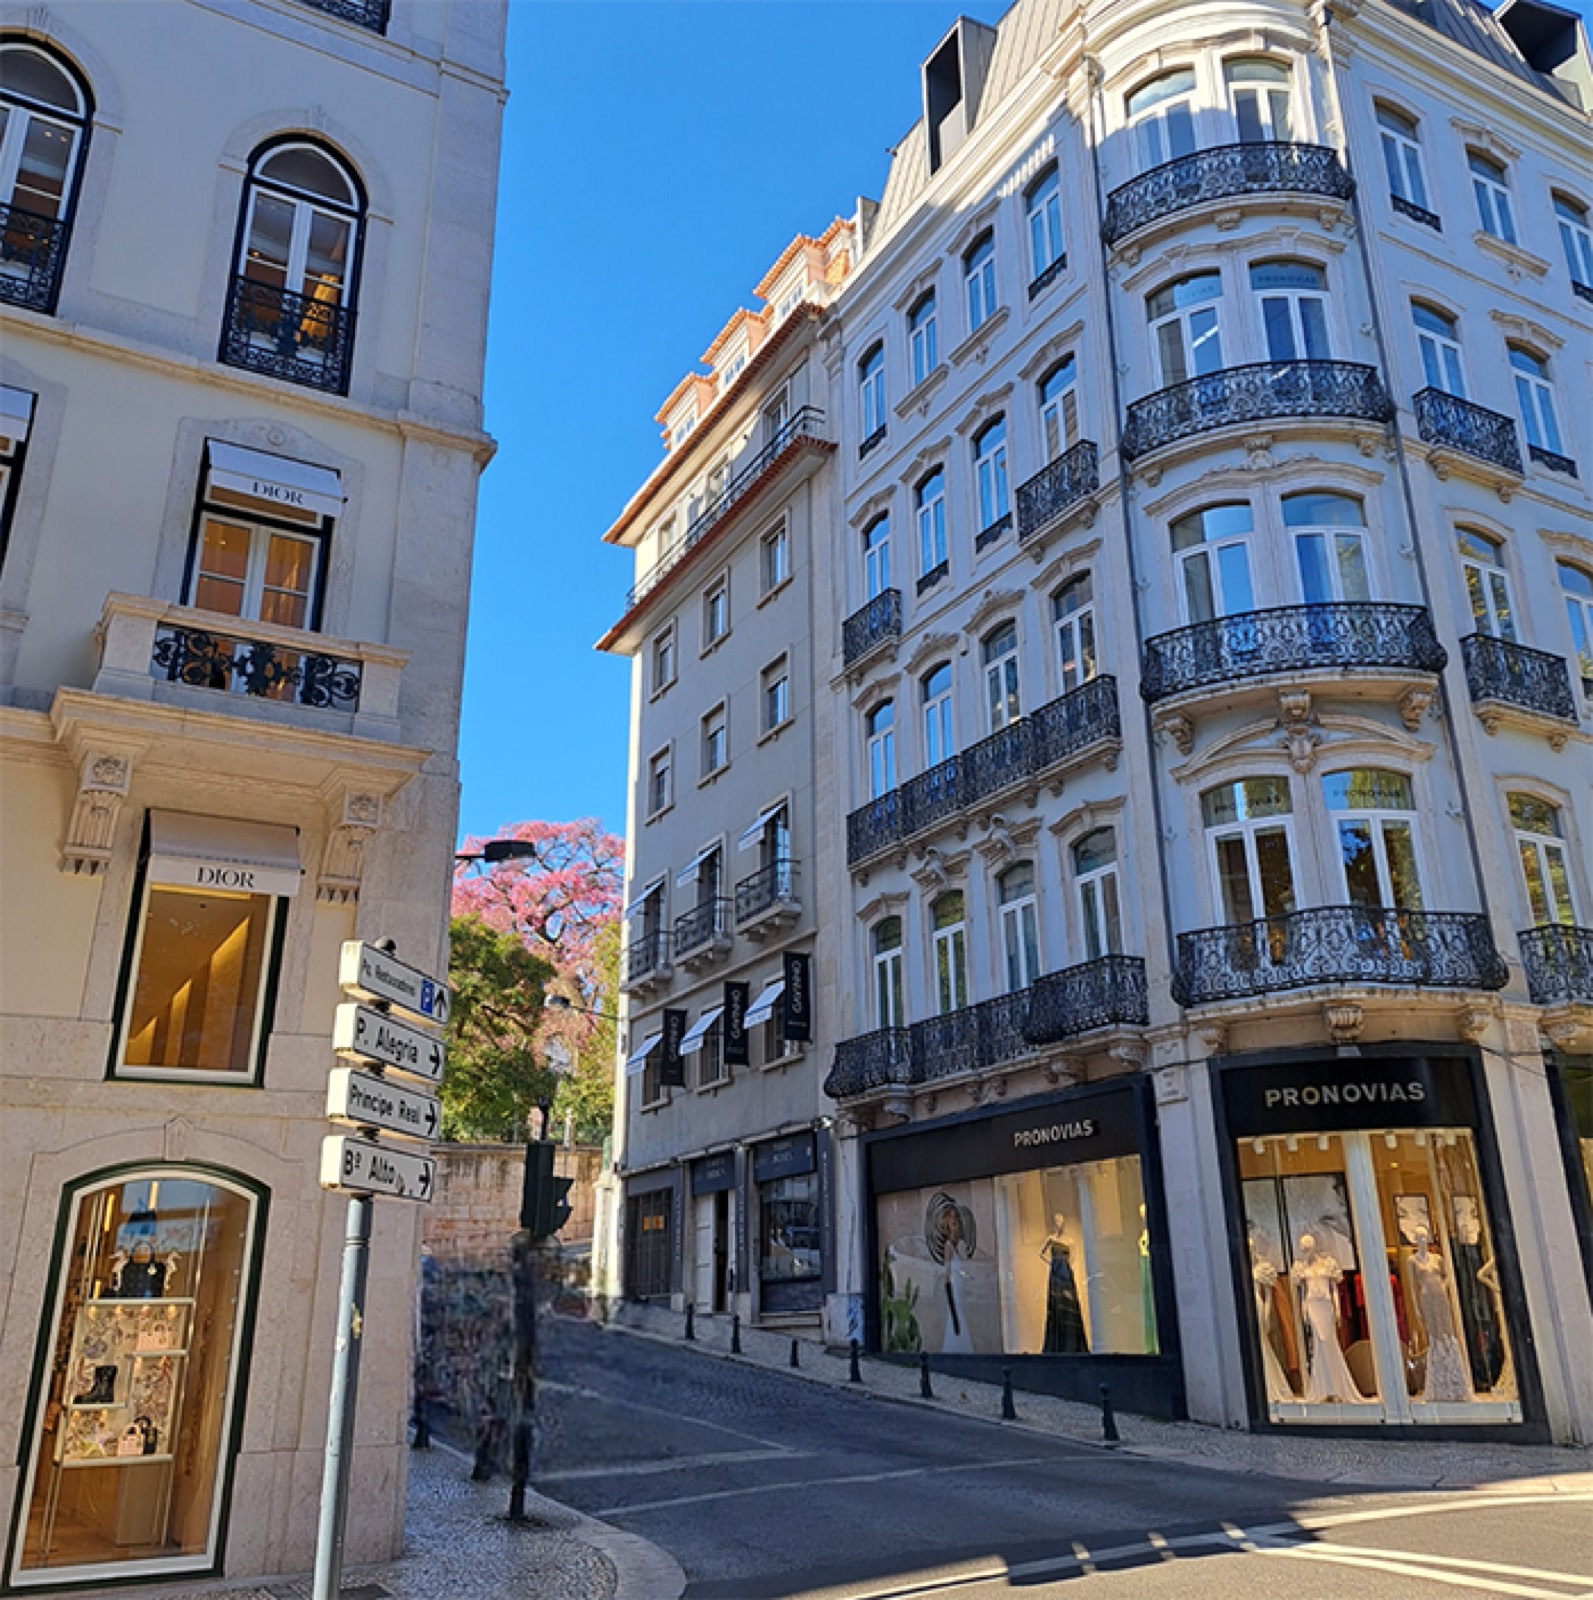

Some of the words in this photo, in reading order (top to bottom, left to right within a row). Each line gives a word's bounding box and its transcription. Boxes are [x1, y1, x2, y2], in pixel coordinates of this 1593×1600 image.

[252, 481, 304, 507] DIOR
[196, 866, 254, 889] DIOR
[355, 1016, 369, 1045] P.
[375, 1026, 418, 1064] Alegria
[1264, 1081, 1426, 1109] PRONOVIAS
[398, 1099, 421, 1125] Real
[1014, 1119, 1094, 1148] PRONOVIAS
[368, 1155, 395, 1185] Alto
